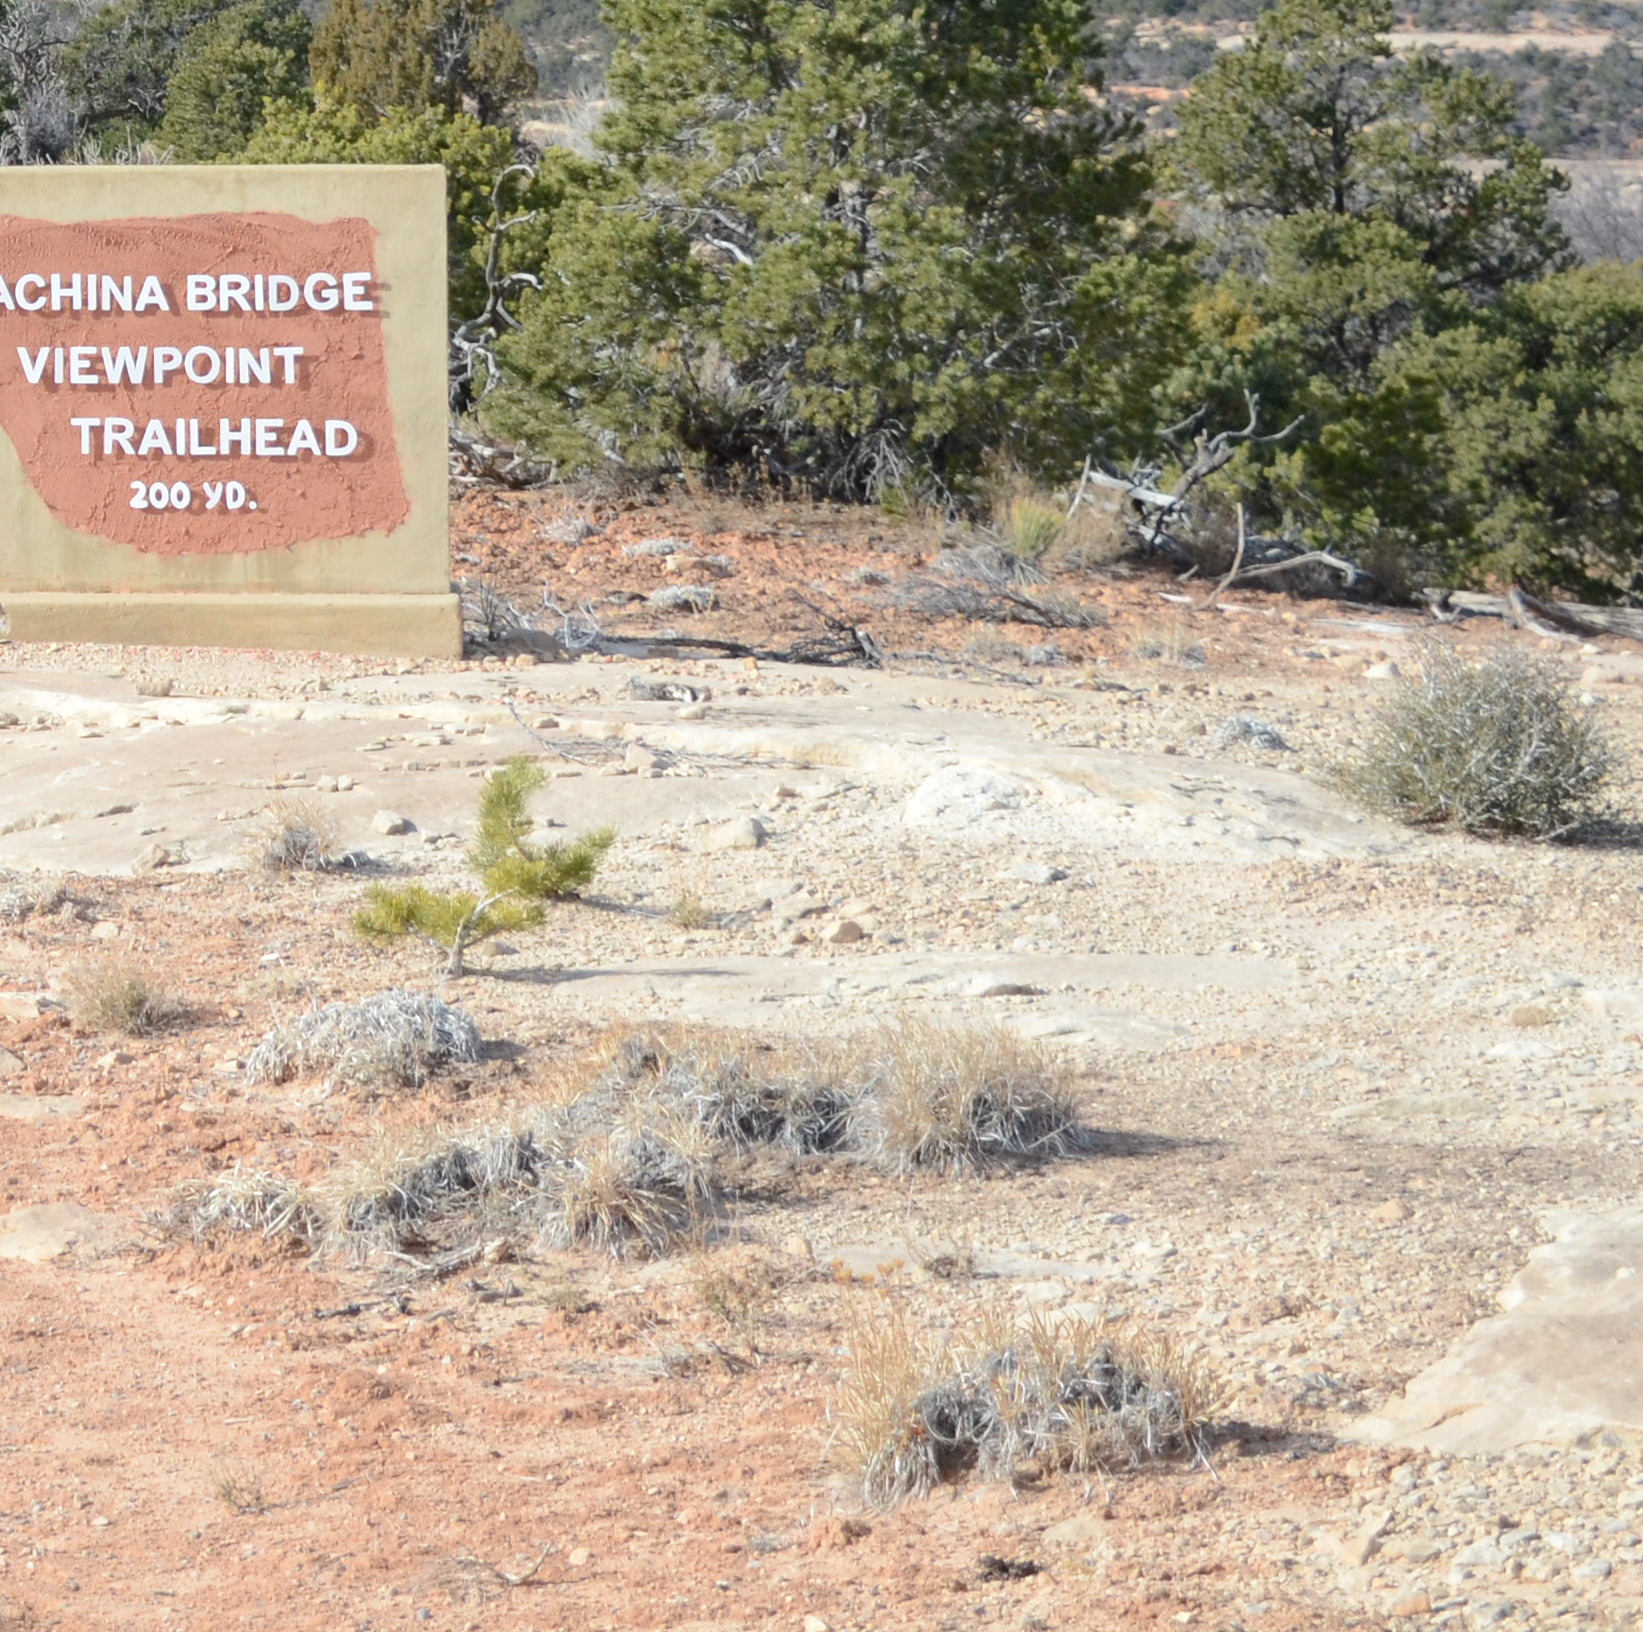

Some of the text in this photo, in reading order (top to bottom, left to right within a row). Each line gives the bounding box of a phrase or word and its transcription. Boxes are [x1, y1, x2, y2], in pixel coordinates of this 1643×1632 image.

[186, 271, 374, 312] BRIDGE
[16, 345, 304, 385] VIEWPOINT
[70, 416, 358, 457] TRAILHEAD
[129, 480, 257, 510] 200 YD.
